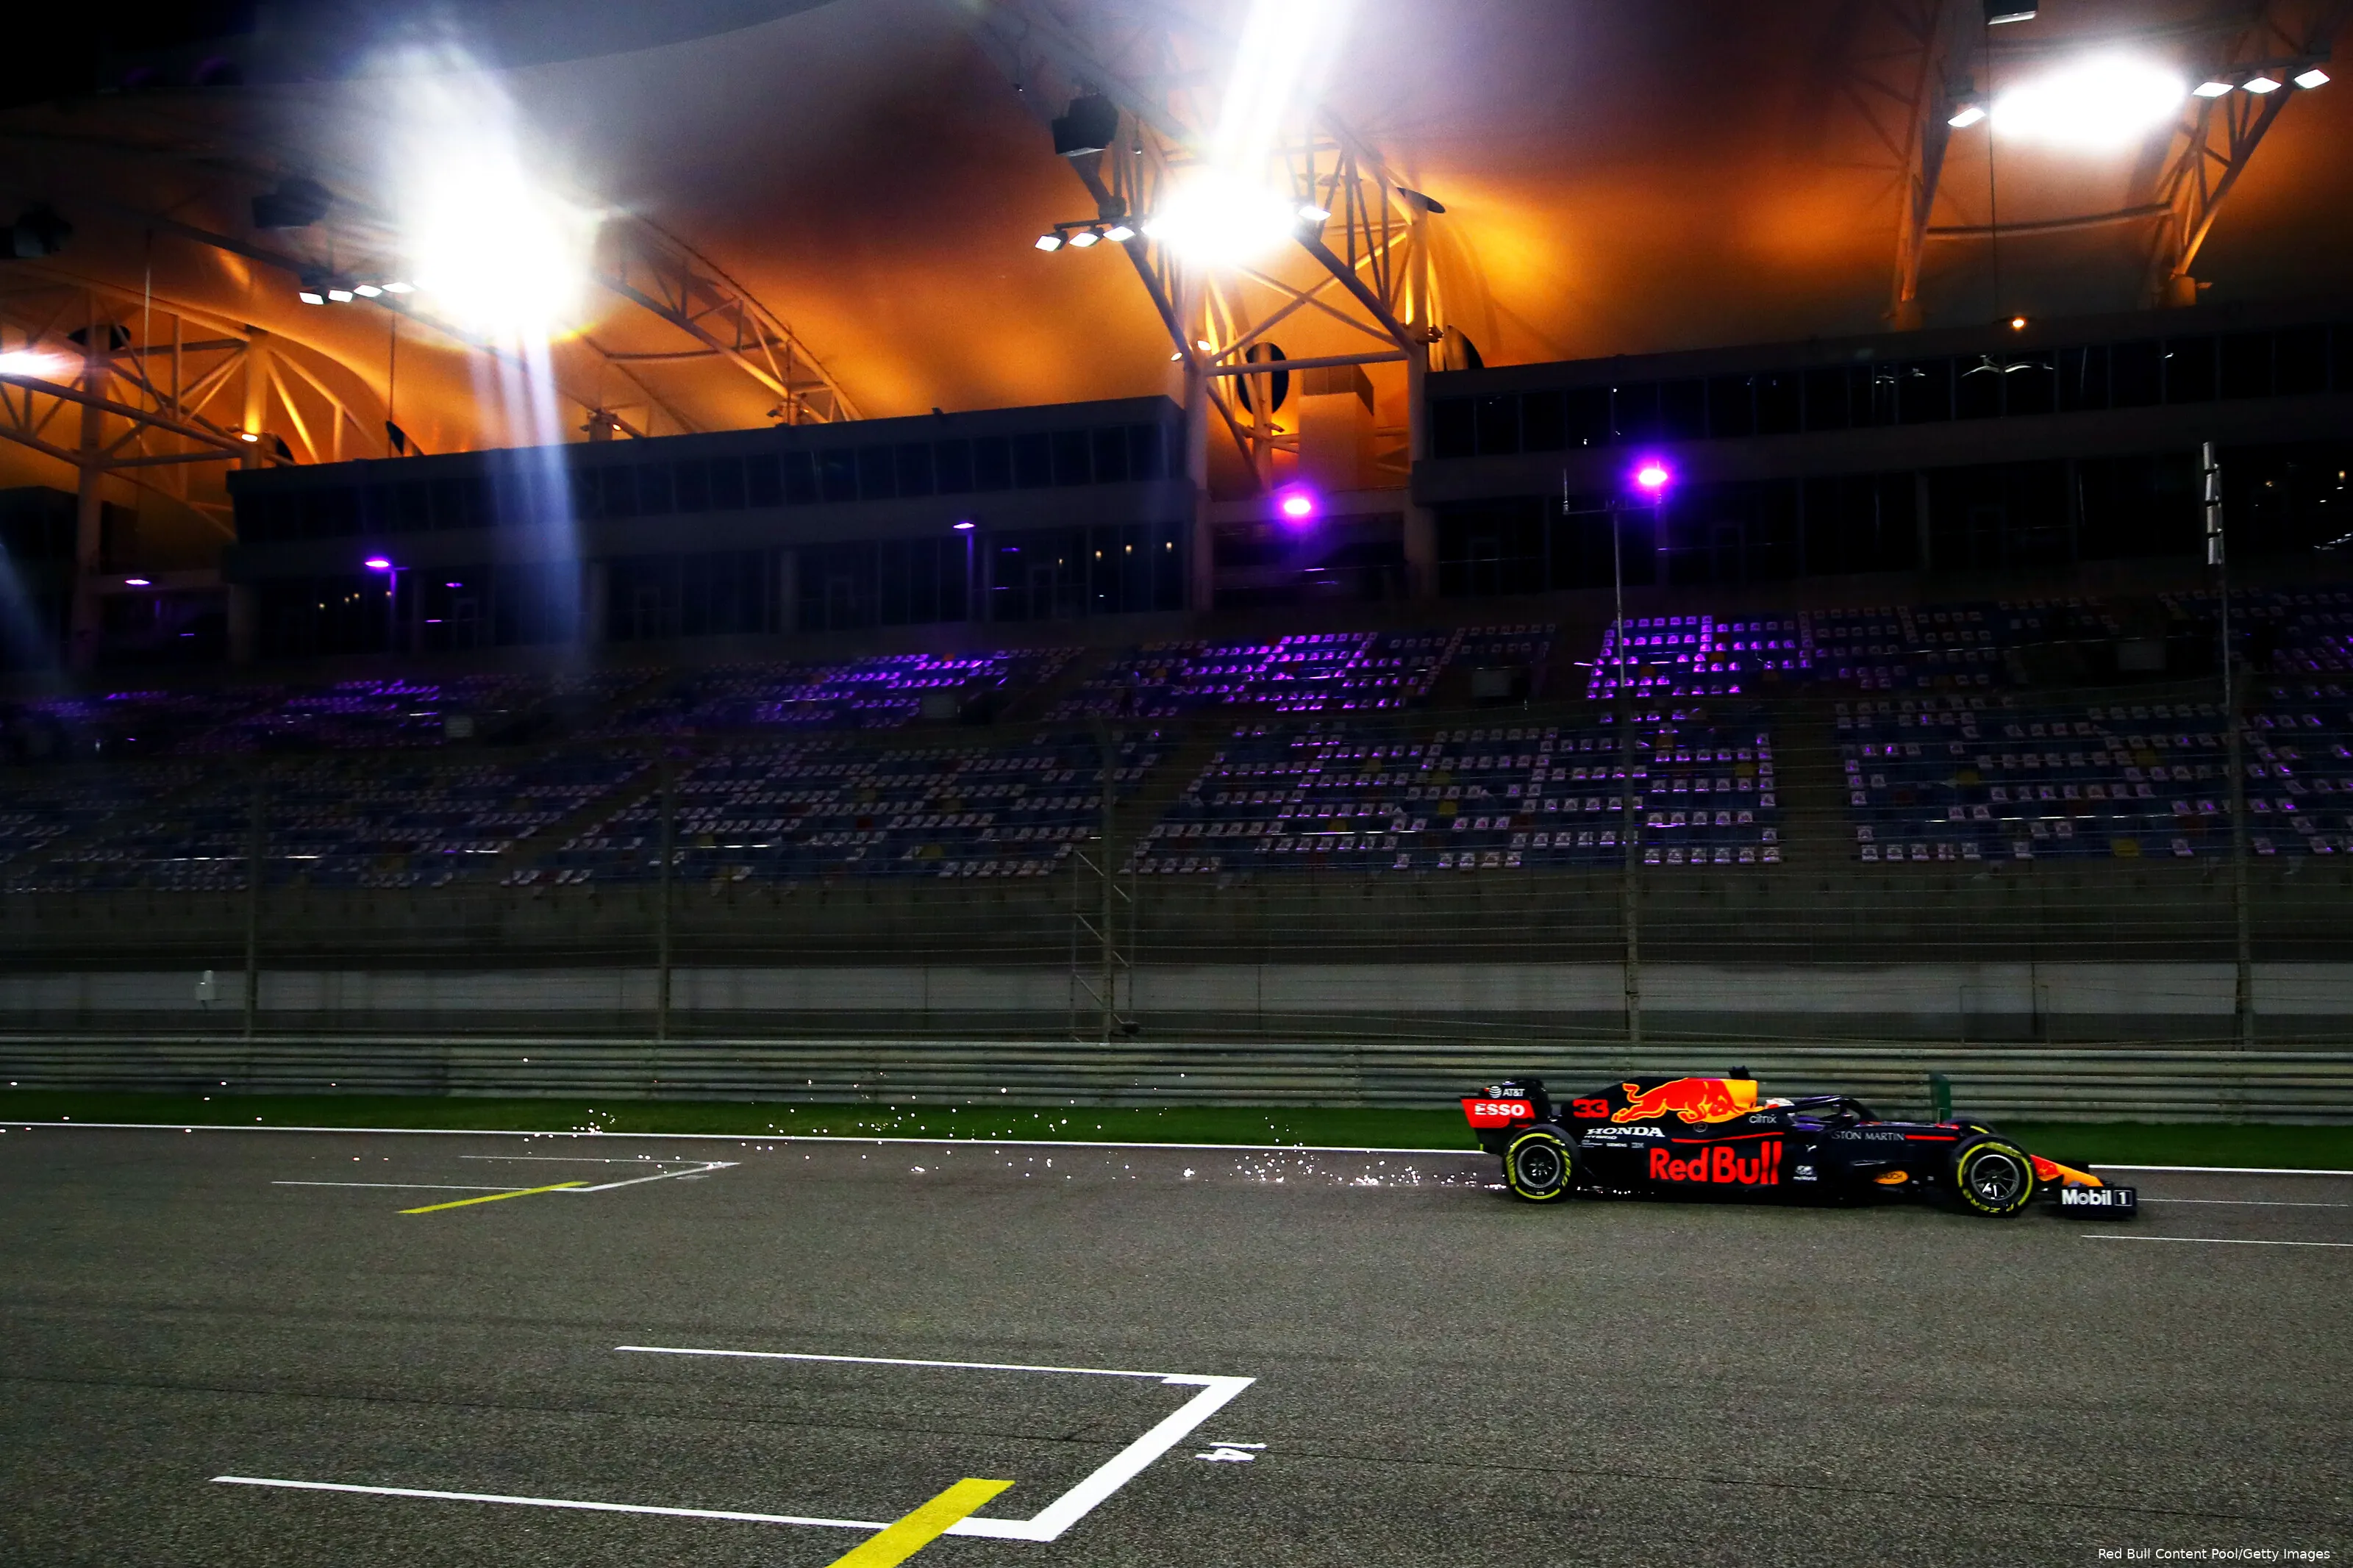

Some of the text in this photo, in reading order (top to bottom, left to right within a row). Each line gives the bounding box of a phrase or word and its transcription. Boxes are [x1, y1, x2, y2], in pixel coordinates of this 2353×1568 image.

[1502, 1088, 1525, 1097] AT&T
[1474, 1103, 1525, 1117] ESSO
[1572, 1098, 1609, 1117] 33
[1586, 1126, 1665, 1138] HONDA
[1831, 1131, 1904, 1141] STON MARTIN
[1649, 1141, 1782, 1185] Red Bull
[2061, 1189, 2112, 1206] Mobil
